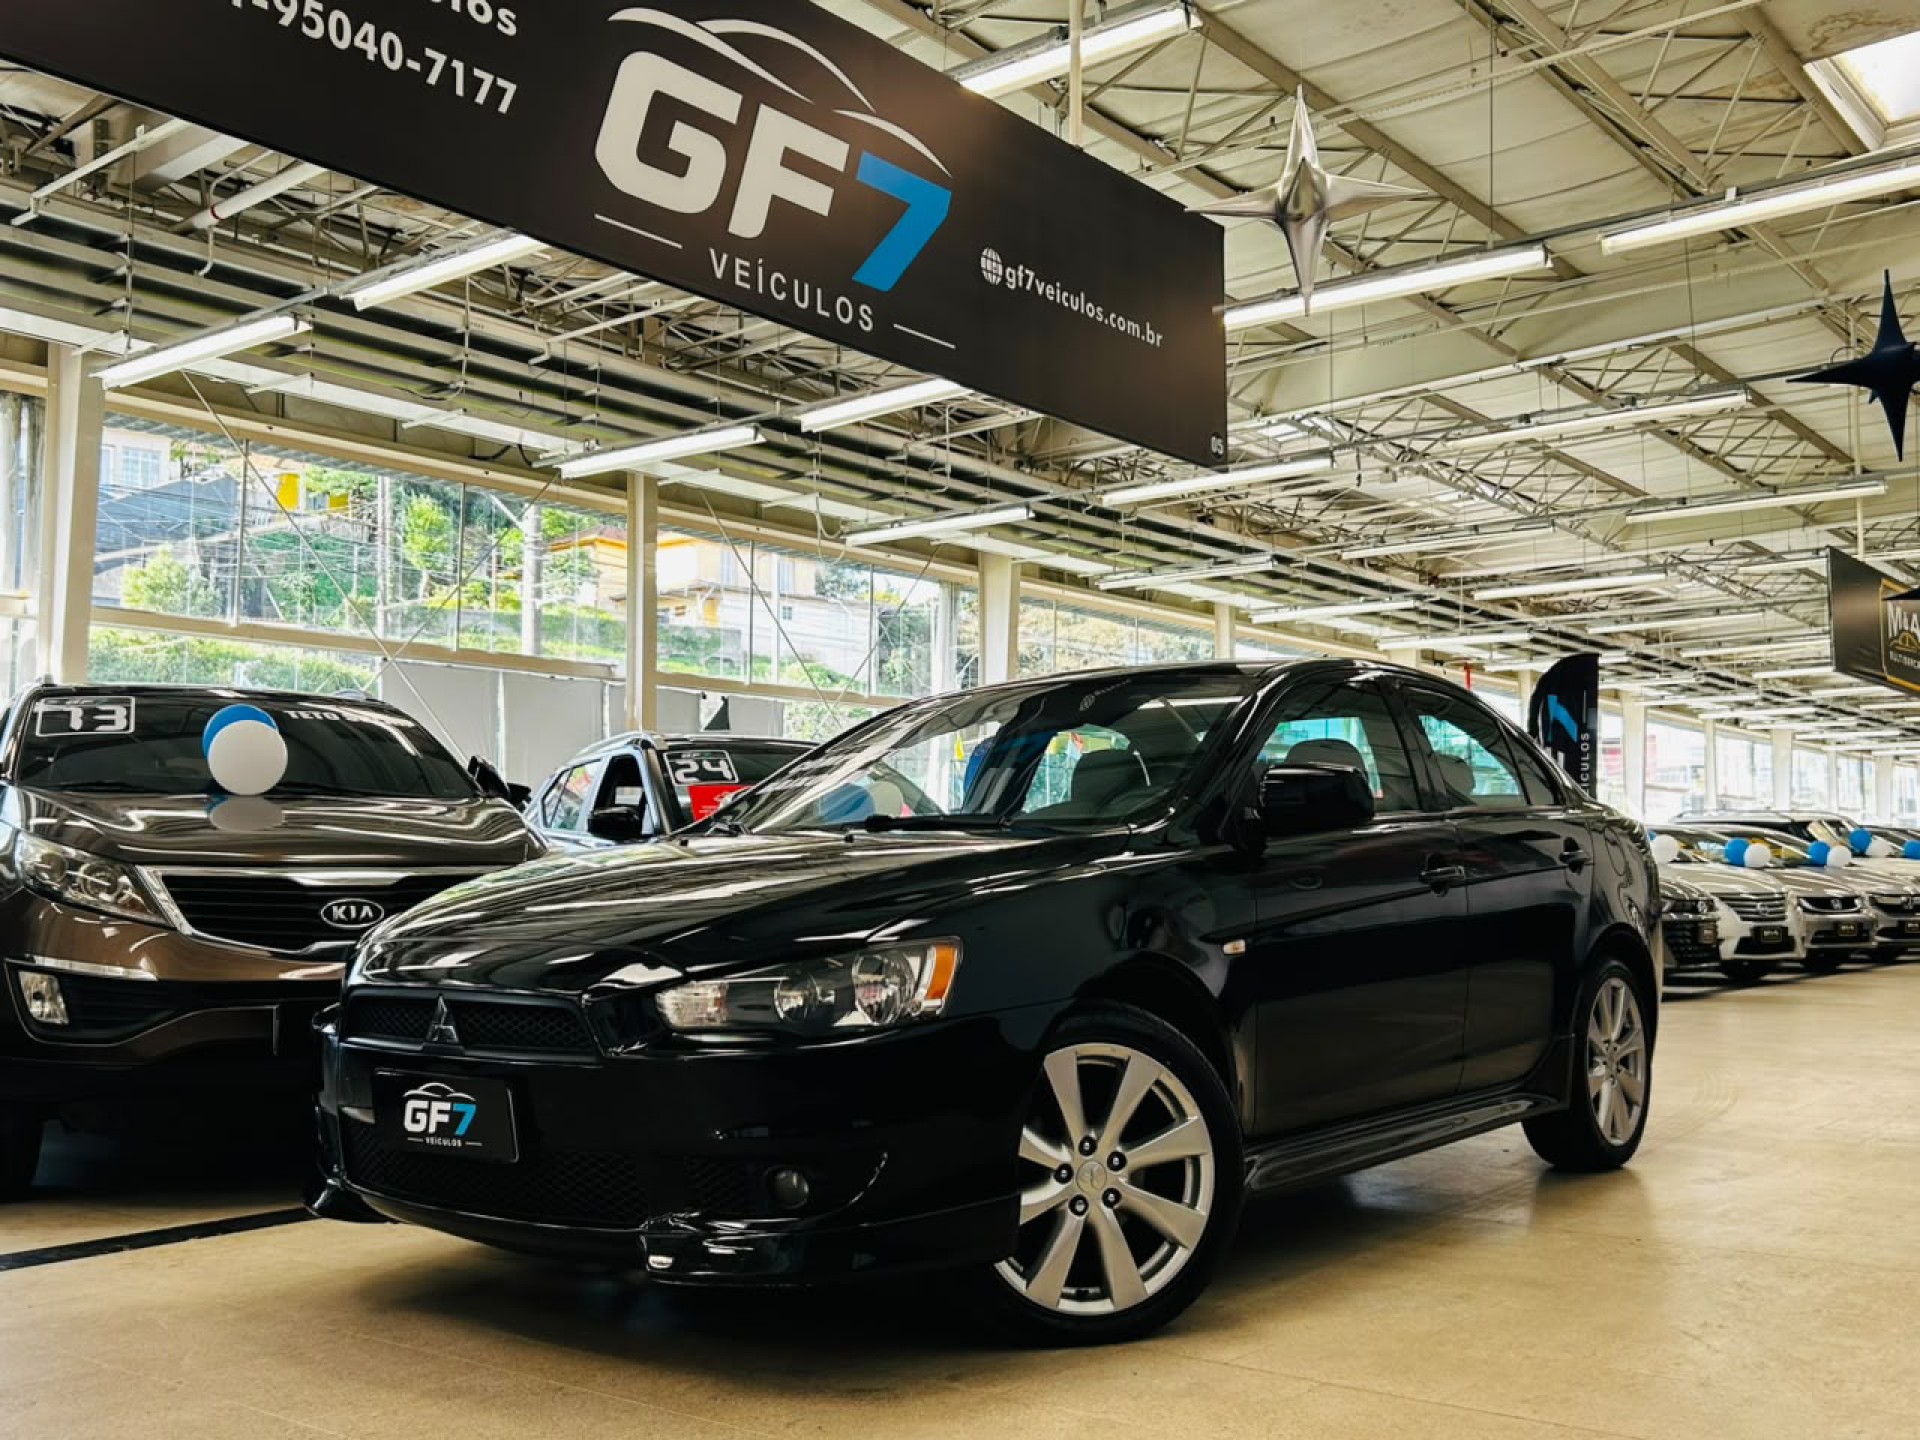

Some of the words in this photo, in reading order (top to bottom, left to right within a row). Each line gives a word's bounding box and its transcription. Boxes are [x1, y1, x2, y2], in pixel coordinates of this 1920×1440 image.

[594, 50, 952, 292] GF7
[709, 248, 873, 332] VEÍCULOS
[1005, 264, 1163, 347] gf7veiculos.com.br
[674, 759, 733, 784] 24
[332, 905, 374, 921] KIA
[404, 1100, 477, 1136] GF7
